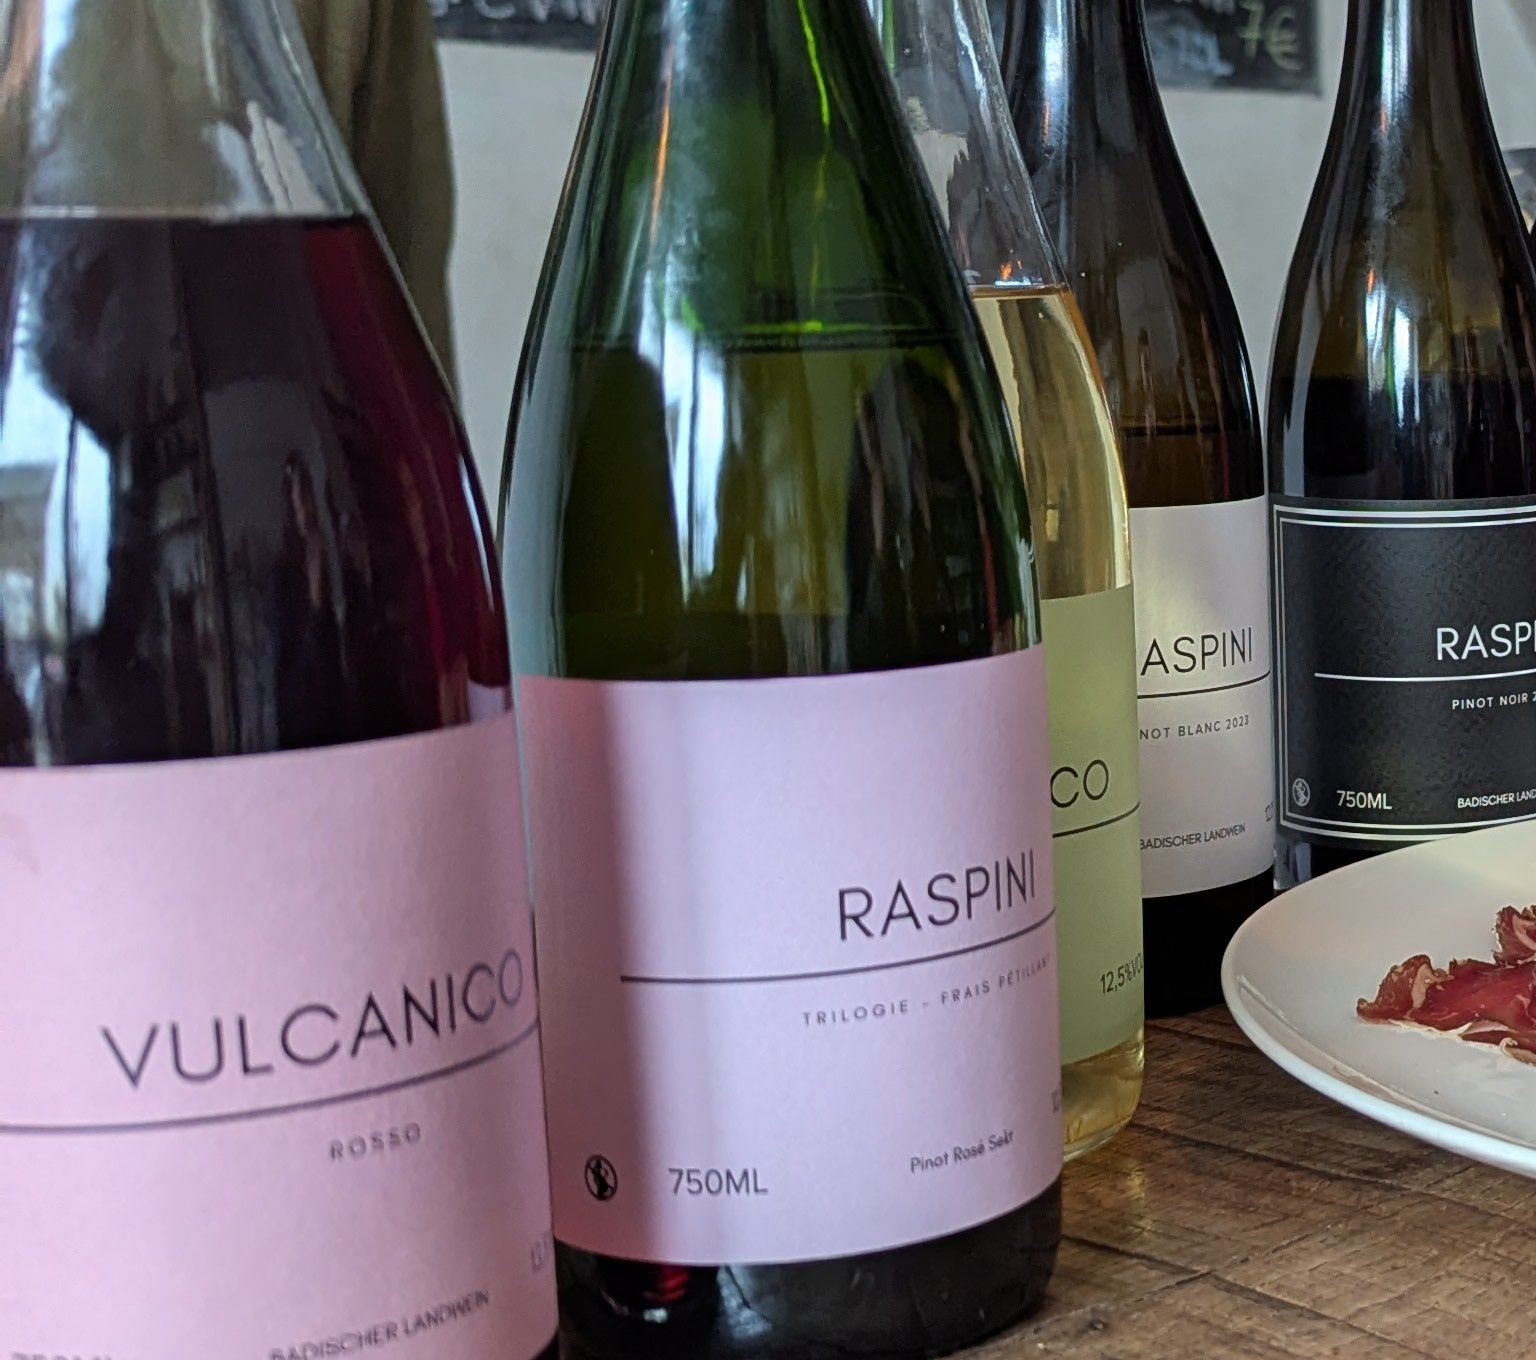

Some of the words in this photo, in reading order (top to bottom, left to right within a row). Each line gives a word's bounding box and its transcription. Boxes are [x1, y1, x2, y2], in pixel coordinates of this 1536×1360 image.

[1139, 626, 1253, 677] ASPINI
[1451, 696, 1495, 711] PINOT
[1499, 692, 1529, 707] NOIR
[1138, 726, 1172, 741] NOT
[1177, 720, 1222, 738] BLANC
[1225, 713, 1251, 731] 2023
[1336, 790, 1393, 811] 750ML
[1456, 792, 1516, 809] BADISCHER
[1202, 822, 1247, 843] LANDWEIN
[838, 847, 1037, 942] RASPINI
[101, 947, 523, 1089] VULCANICO
[803, 999, 911, 1027] TRILOGIE
[940, 979, 992, 1006] FRAIS
[329, 1122, 423, 1162] ROSSO
[909, 1152, 950, 1174] Pinot
[952, 1139, 986, 1164] Rosé
[667, 1168, 769, 1196] 750ML
[402, 1290, 491, 1336] LANDWEIN
